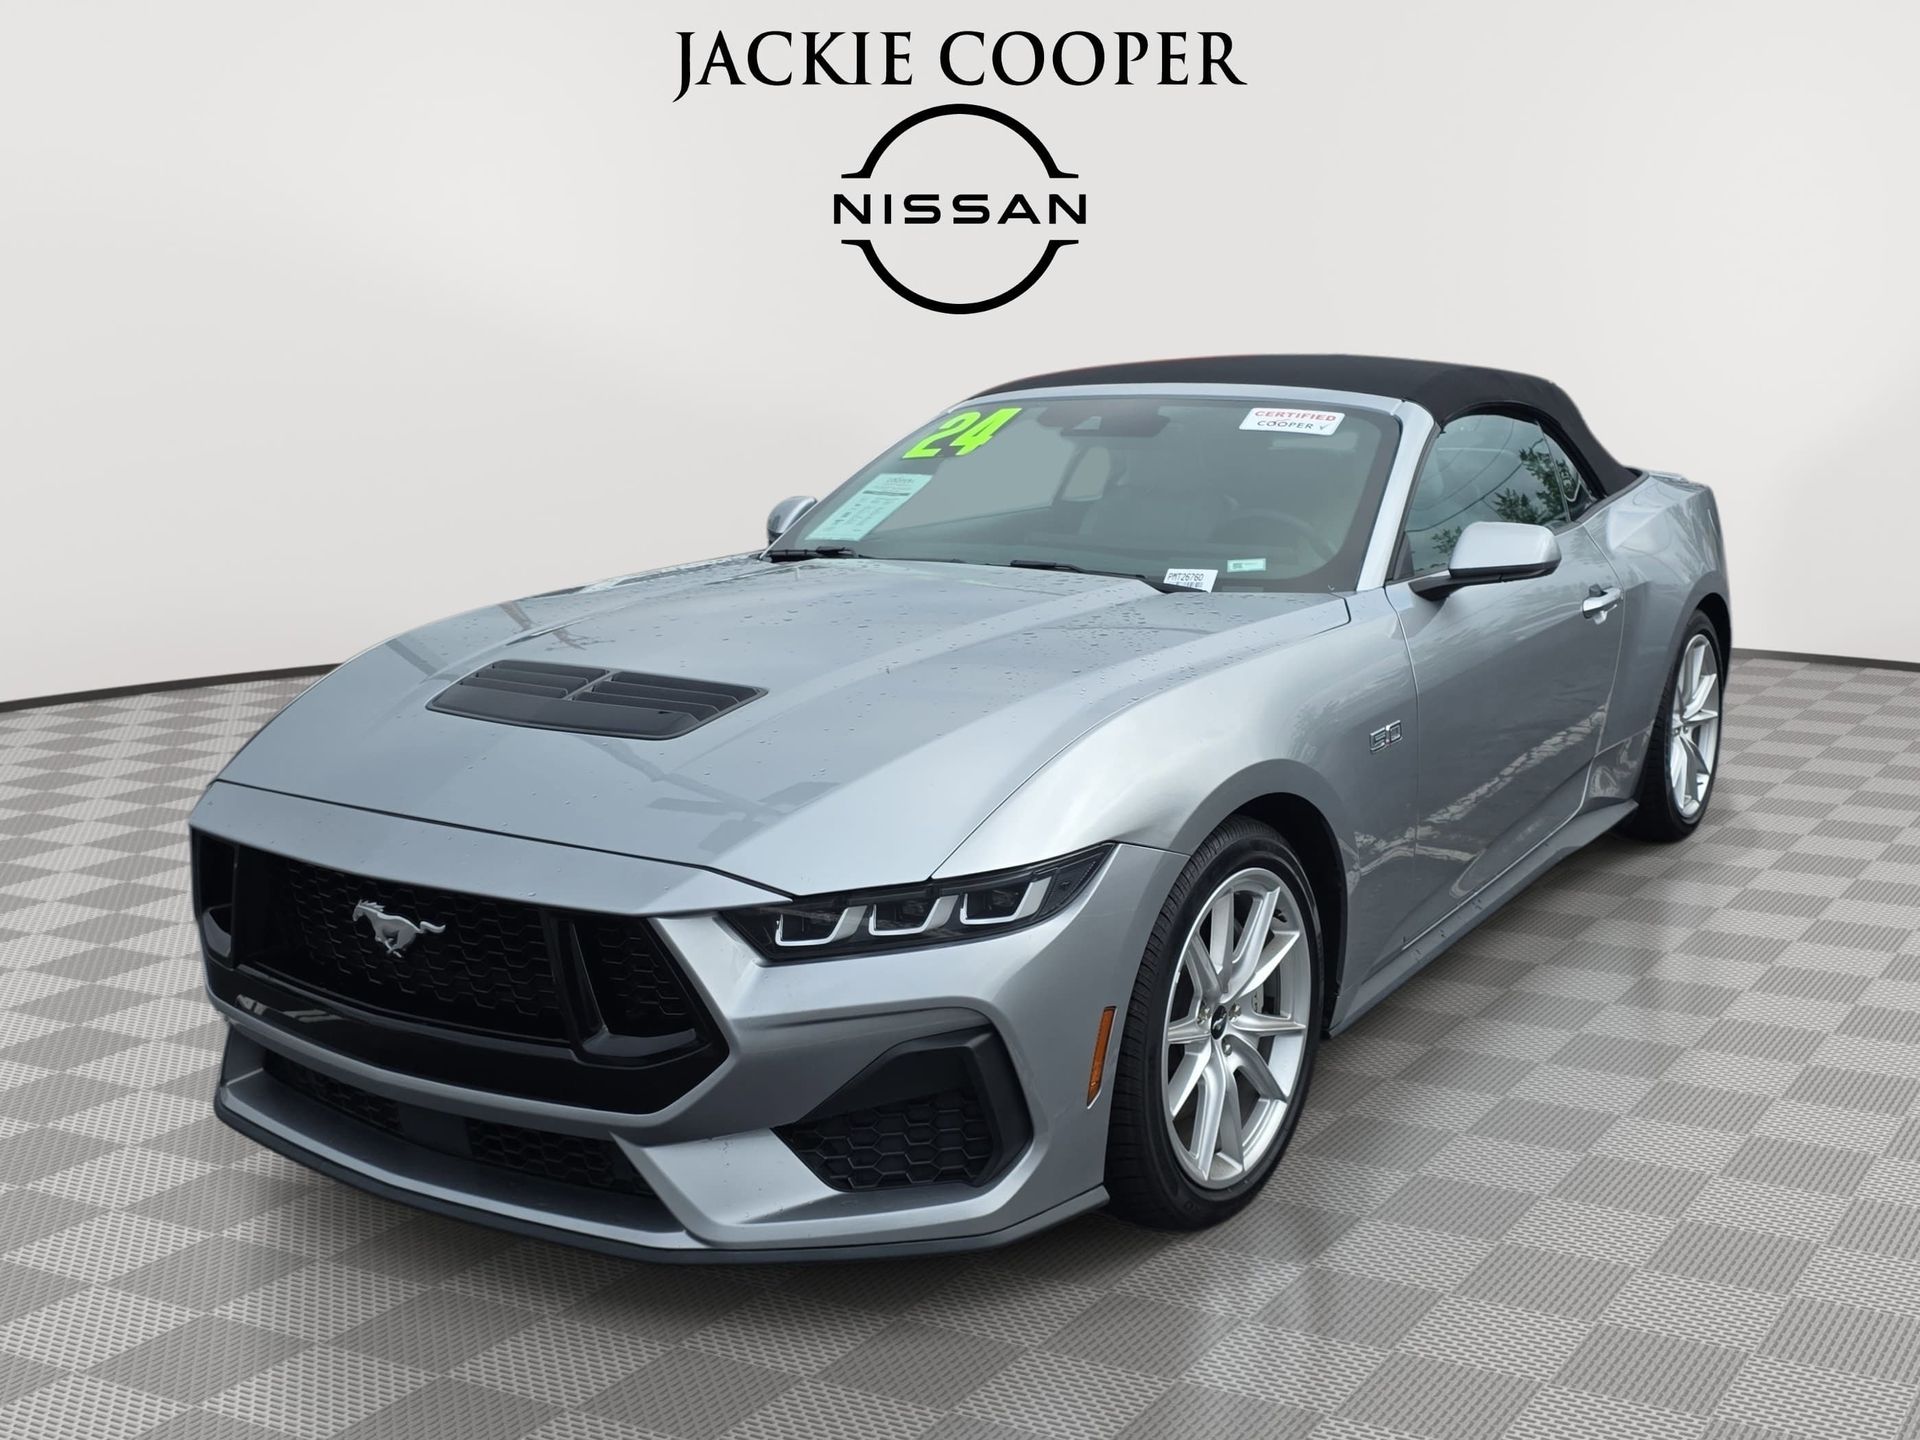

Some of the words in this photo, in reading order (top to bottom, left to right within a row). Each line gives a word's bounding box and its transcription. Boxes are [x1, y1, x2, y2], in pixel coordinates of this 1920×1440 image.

[1254, 410, 1336, 421] CERTIFIED
[1256, 420, 1314, 429] COOPER
[902, 408, 1023, 459] 24
